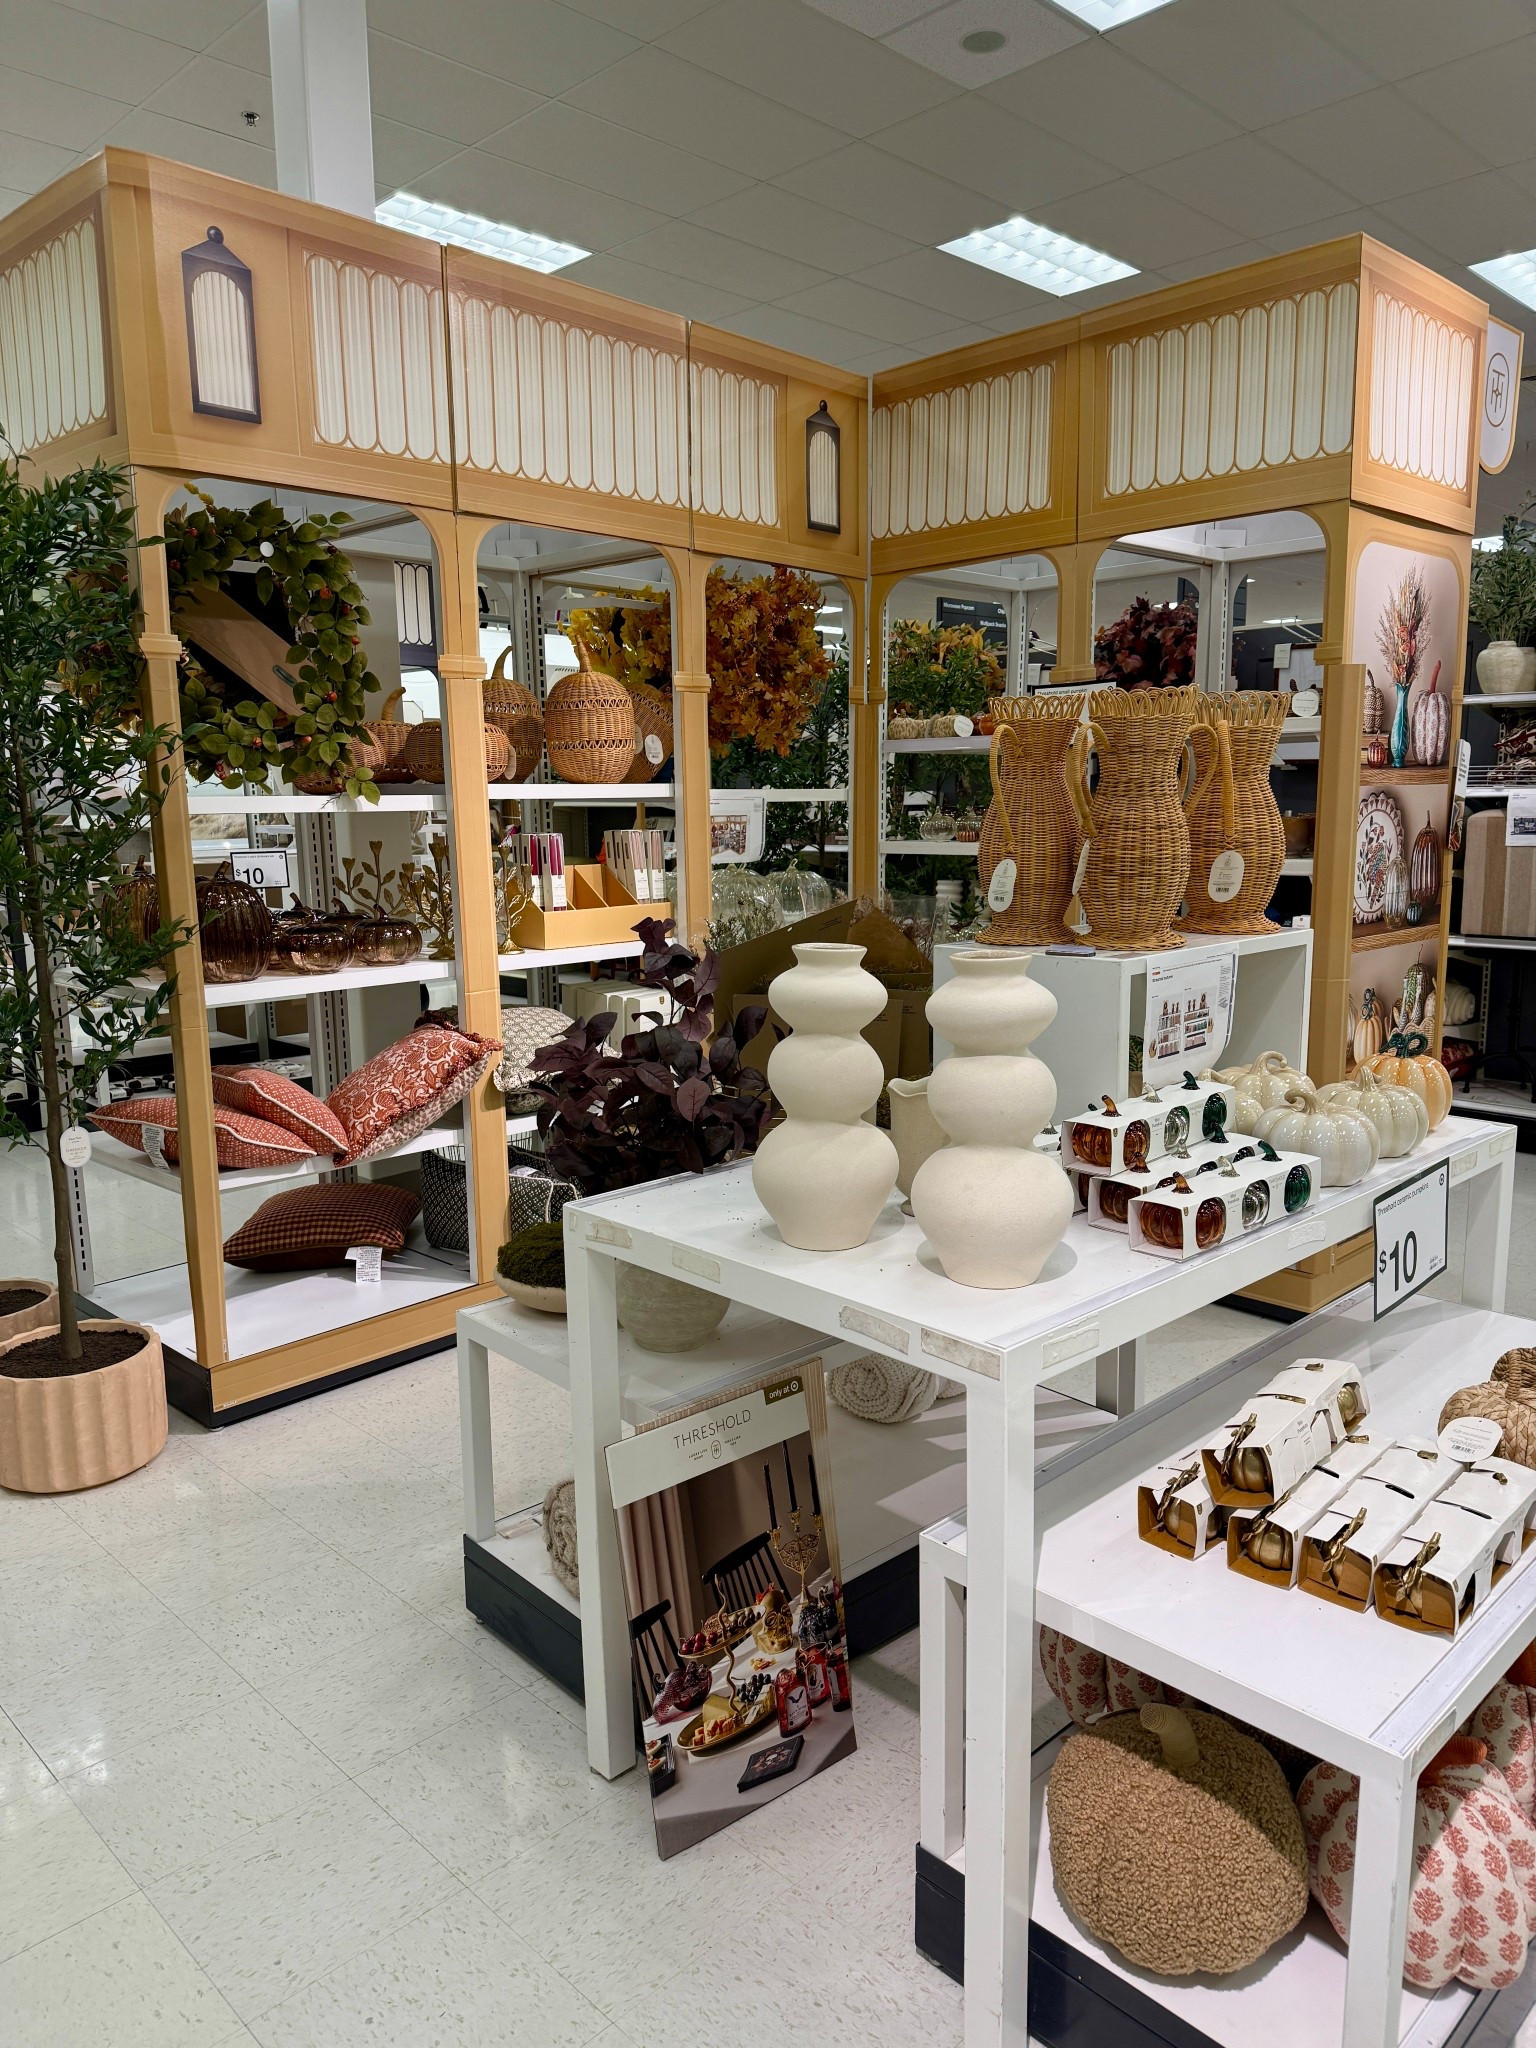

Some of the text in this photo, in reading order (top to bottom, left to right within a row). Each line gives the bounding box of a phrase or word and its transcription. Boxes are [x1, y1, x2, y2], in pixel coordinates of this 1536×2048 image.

[235, 868, 264, 885] $10
[1377, 1182, 1429, 1217] Threshold ceramic pumpkins
[1379, 1231, 1418, 1292] $10
[769, 1385, 790, 1400] only at
[673, 1409, 751, 1449] THRESHOLD
